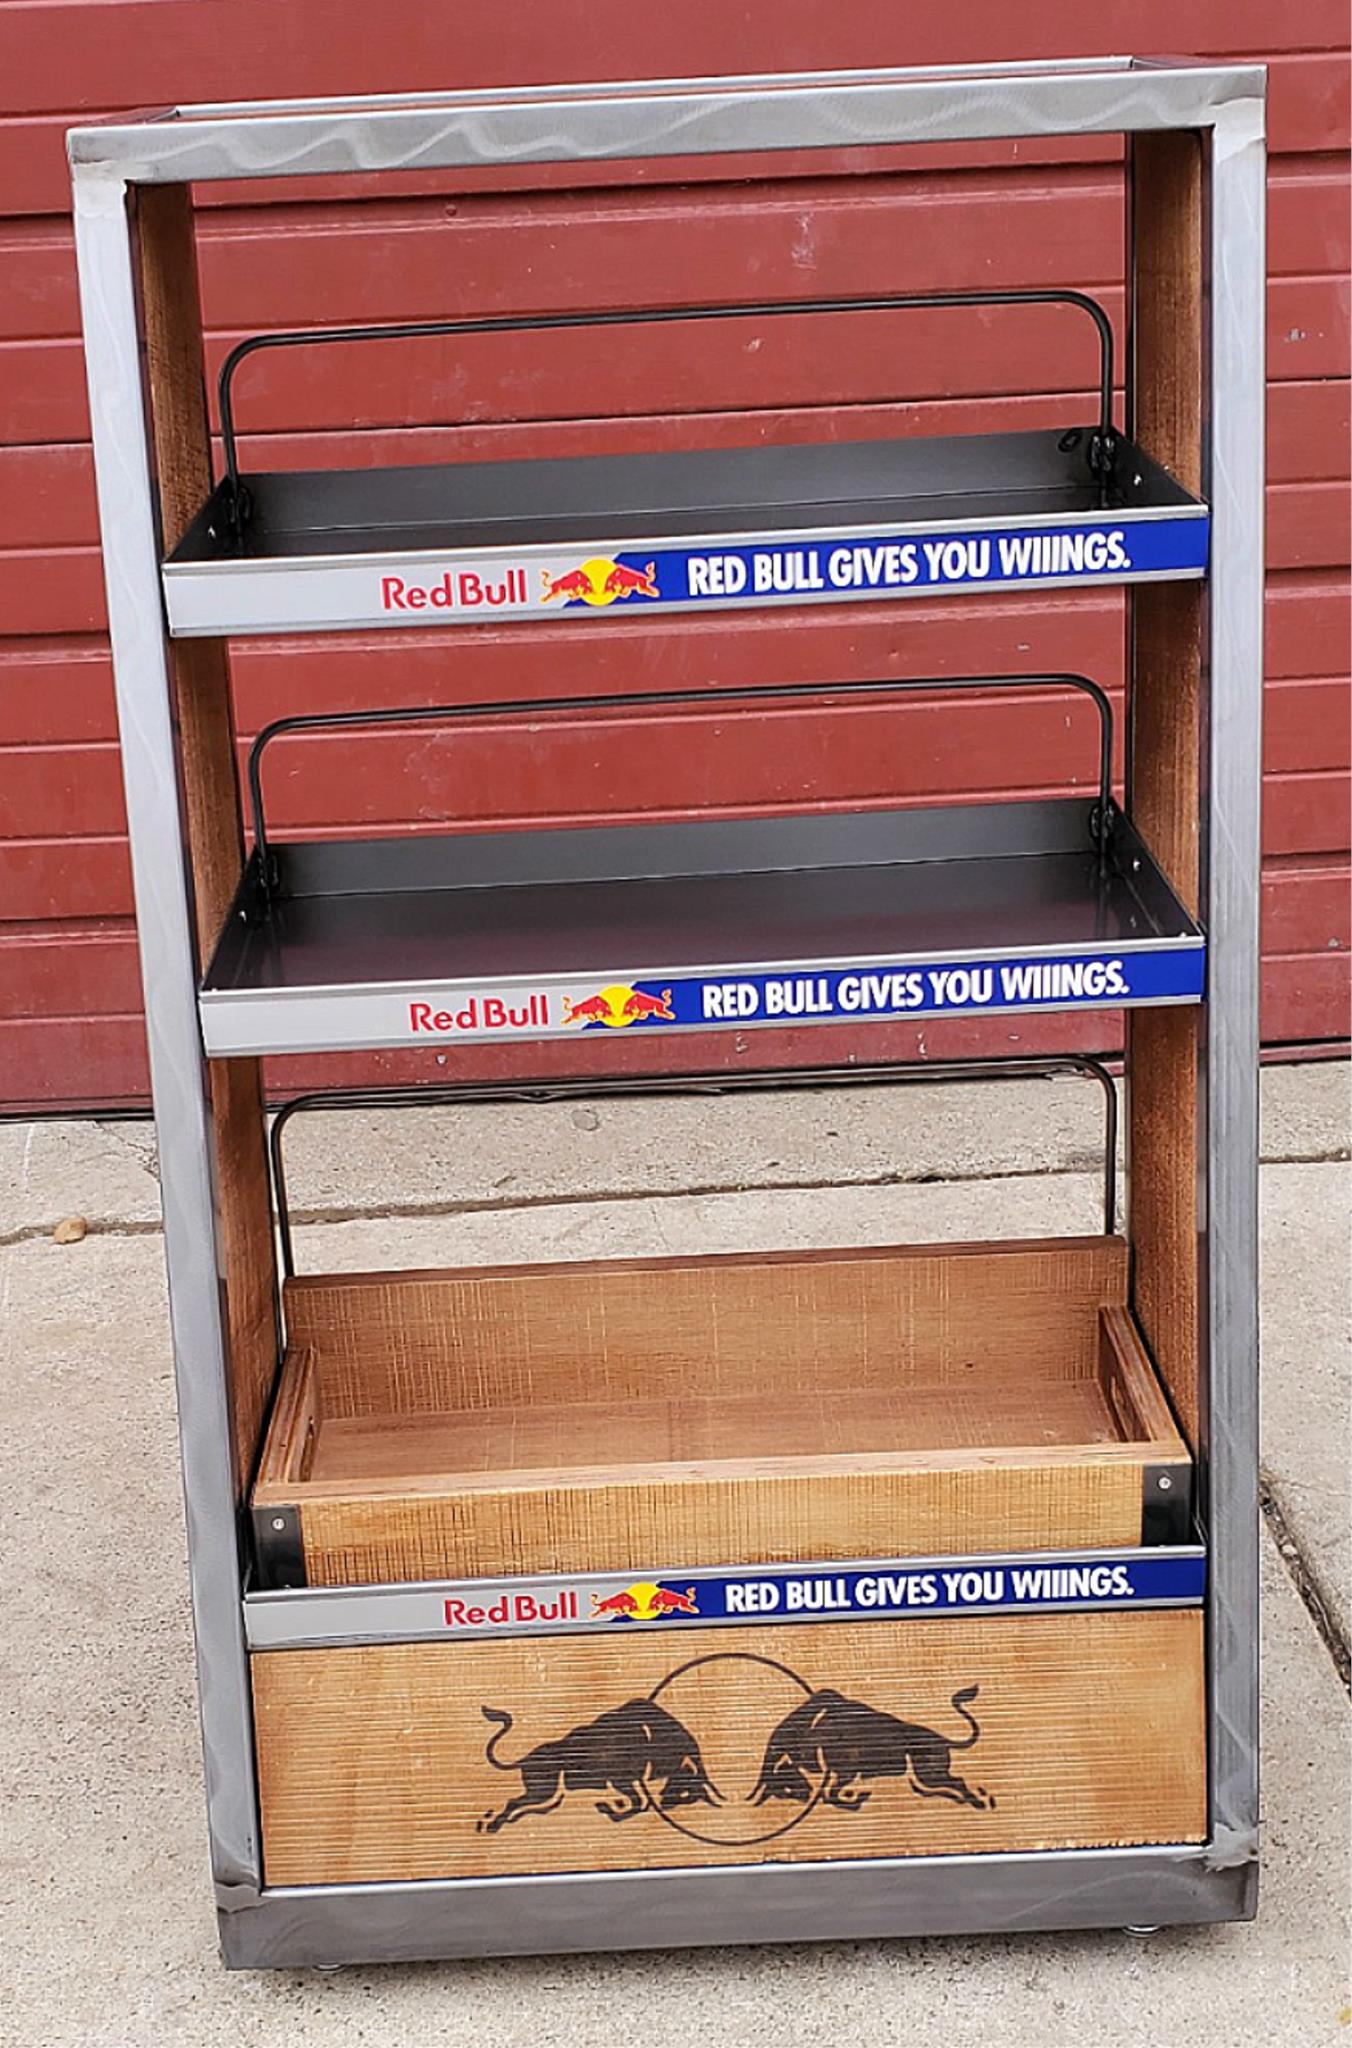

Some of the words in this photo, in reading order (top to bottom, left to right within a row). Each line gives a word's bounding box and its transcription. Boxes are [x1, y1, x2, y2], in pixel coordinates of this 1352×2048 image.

[688, 556, 746, 595] RED
[754, 551, 824, 591] BULL
[829, 545, 918, 586] GIVES
[923, 540, 990, 580] YOU
[999, 532, 1131, 575] WIIINGS.
[382, 572, 453, 609] Red
[459, 569, 526, 606] Bull
[703, 984, 758, 1017] RED
[766, 979, 832, 1013] BULL
[838, 973, 923, 1010] GIVES
[928, 969, 992, 1004] YOU
[1001, 961, 1129, 1000] WIIINGS.
[410, 998, 477, 1032] Red
[483, 995, 548, 1028] Bull
[445, 1597, 509, 1625] Red
[514, 1592, 578, 1621] Bull
[726, 1583, 779, 1612] RED
[787, 1579, 851, 1609] BULL
[855, 1575, 937, 1606] GIVES
[942, 1572, 1003, 1602] YOU
[1011, 1566, 1134, 1598] WIIINGS.
